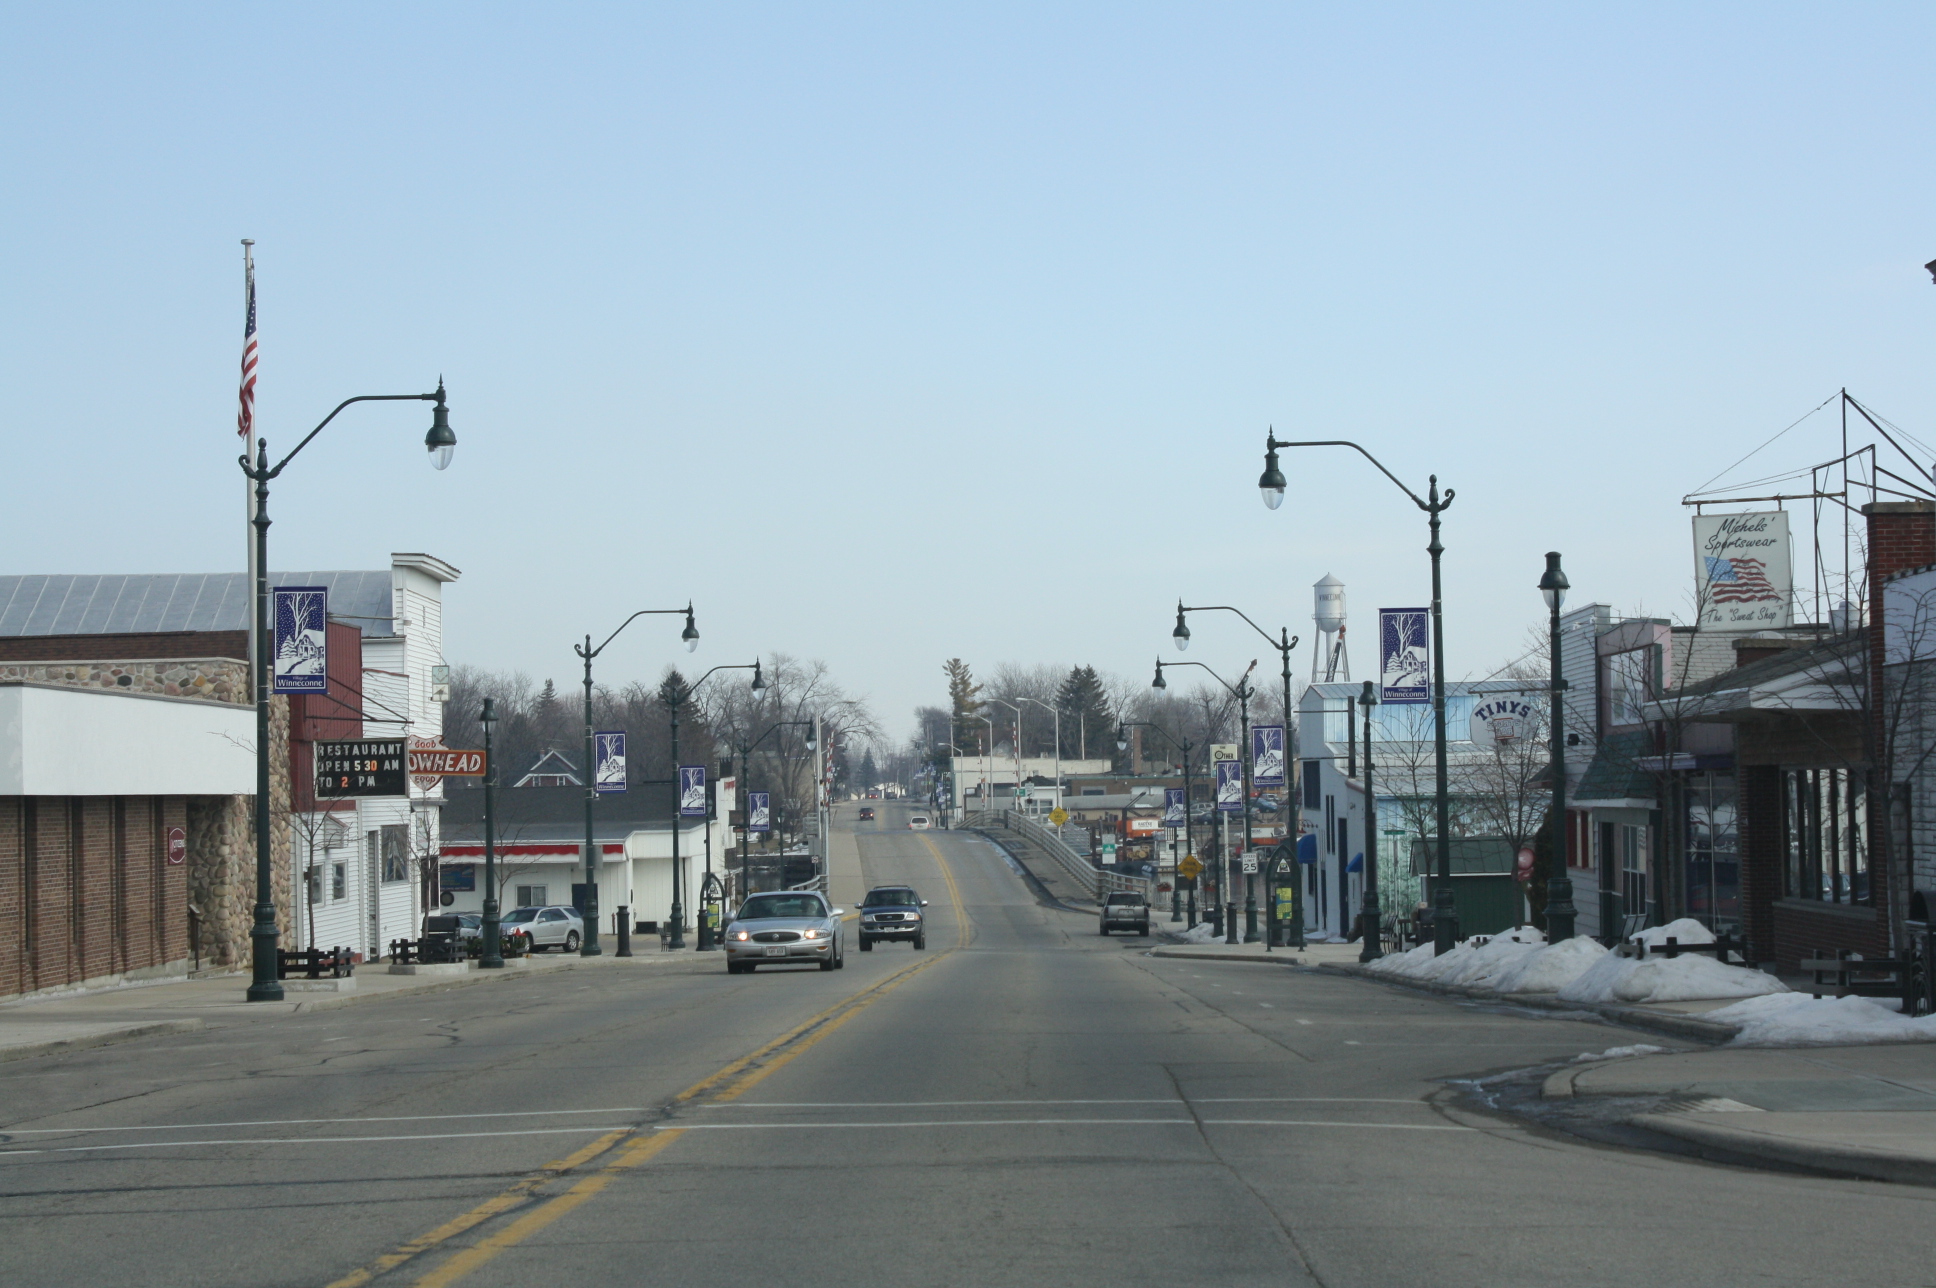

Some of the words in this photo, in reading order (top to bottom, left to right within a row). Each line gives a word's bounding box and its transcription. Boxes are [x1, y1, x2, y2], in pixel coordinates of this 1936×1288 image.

[1716, 517, 1775, 535] Michels'
[1705, 535, 1777, 555] Sportswear
[1700, 609, 1722, 623] The
[1474, 701, 1531, 721] TINYS
[318, 744, 401, 756] RESTAURANT
[1215, 751, 1233, 759] OTHER
[318, 761, 350, 772] OPEN
[384, 760, 399, 770] AM
[319, 777, 332, 787] TO
[341, 776, 348, 787] 2
[358, 776, 375, 786] PM
[1243, 863, 1256, 871] 25
